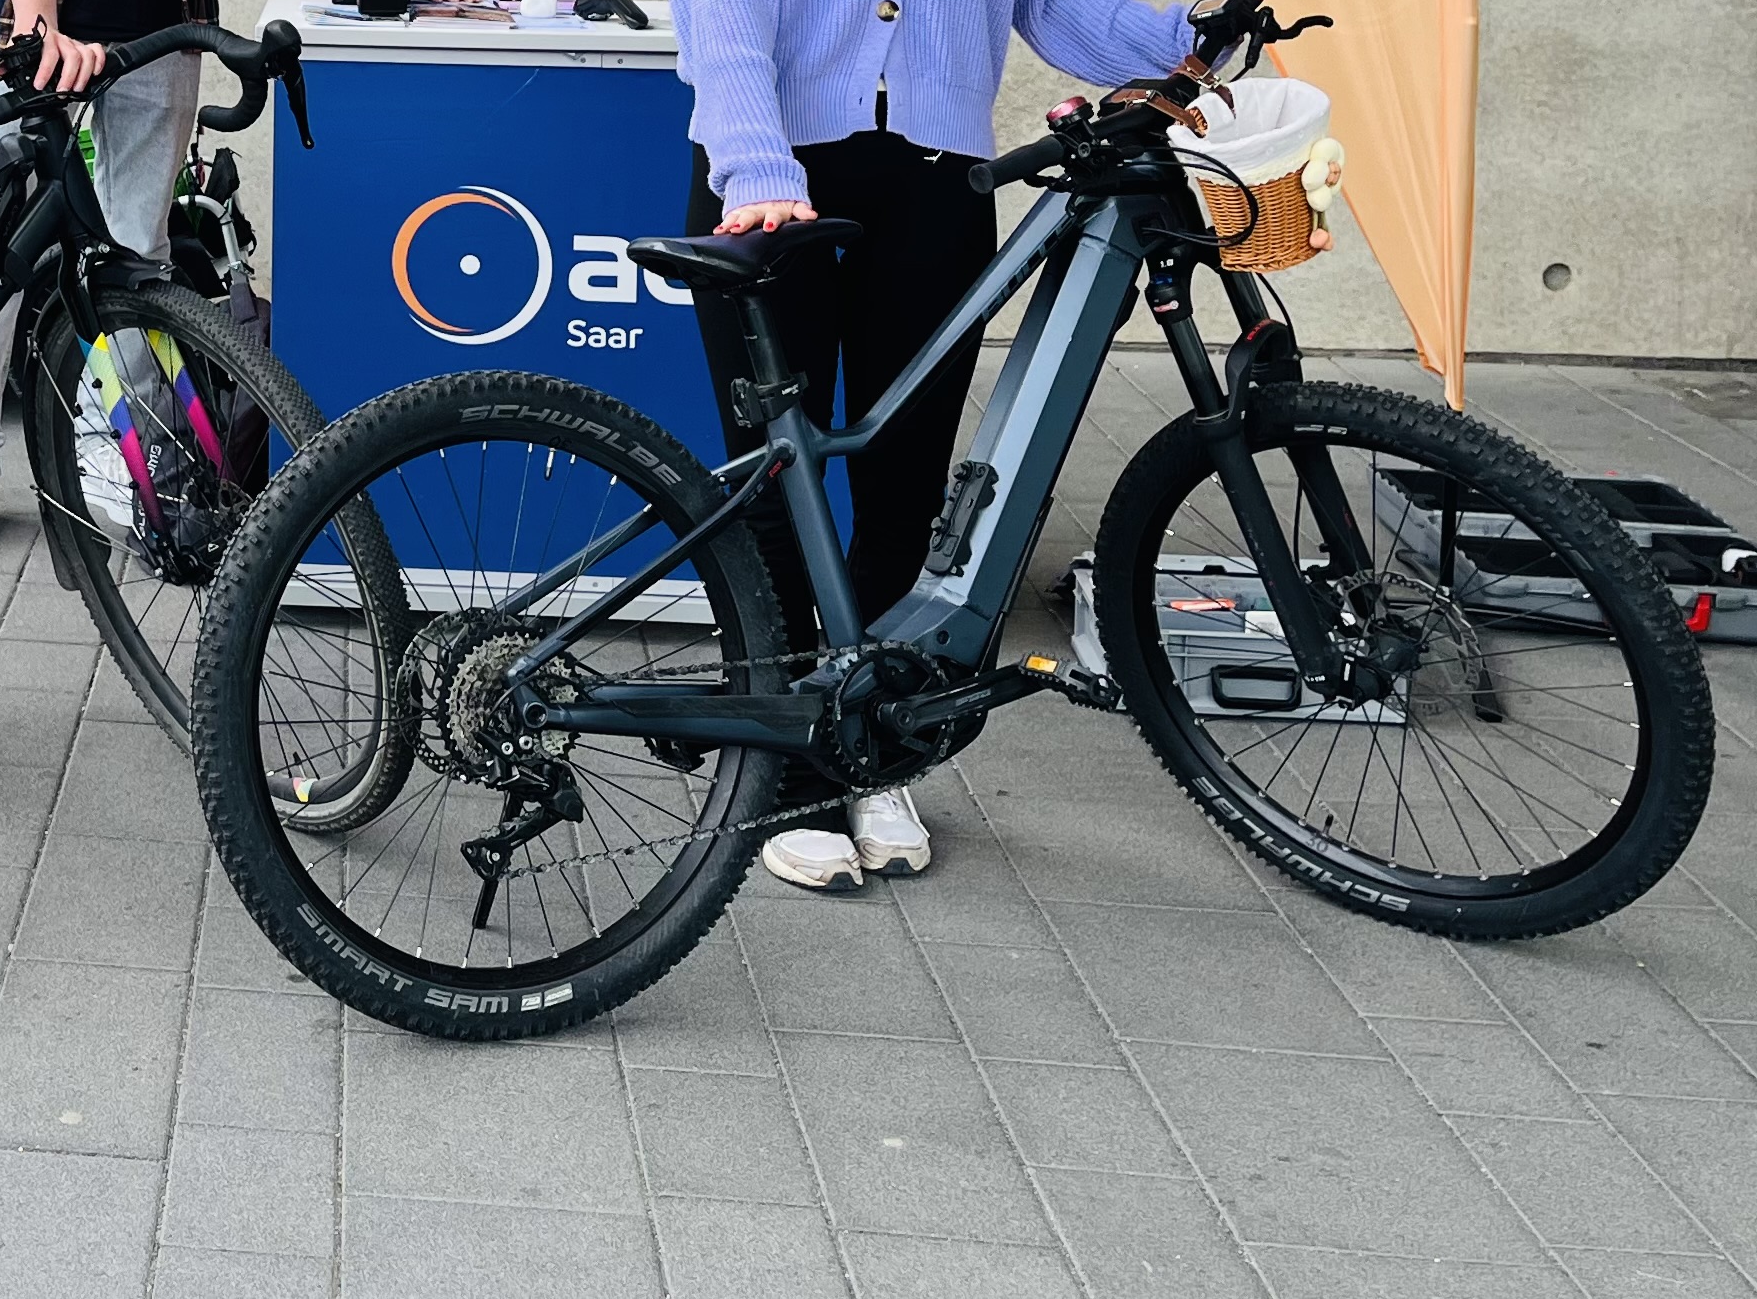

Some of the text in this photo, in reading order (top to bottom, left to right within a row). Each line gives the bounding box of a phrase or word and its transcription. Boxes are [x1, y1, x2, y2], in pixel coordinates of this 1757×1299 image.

[567, 319, 643, 349] Saar
[459, 404, 683, 486] SCHWALBE
[1192, 776, 1412, 913] SCHWALBE
[296, 902, 414, 993] SMART
[423, 987, 509, 1014] SAM
